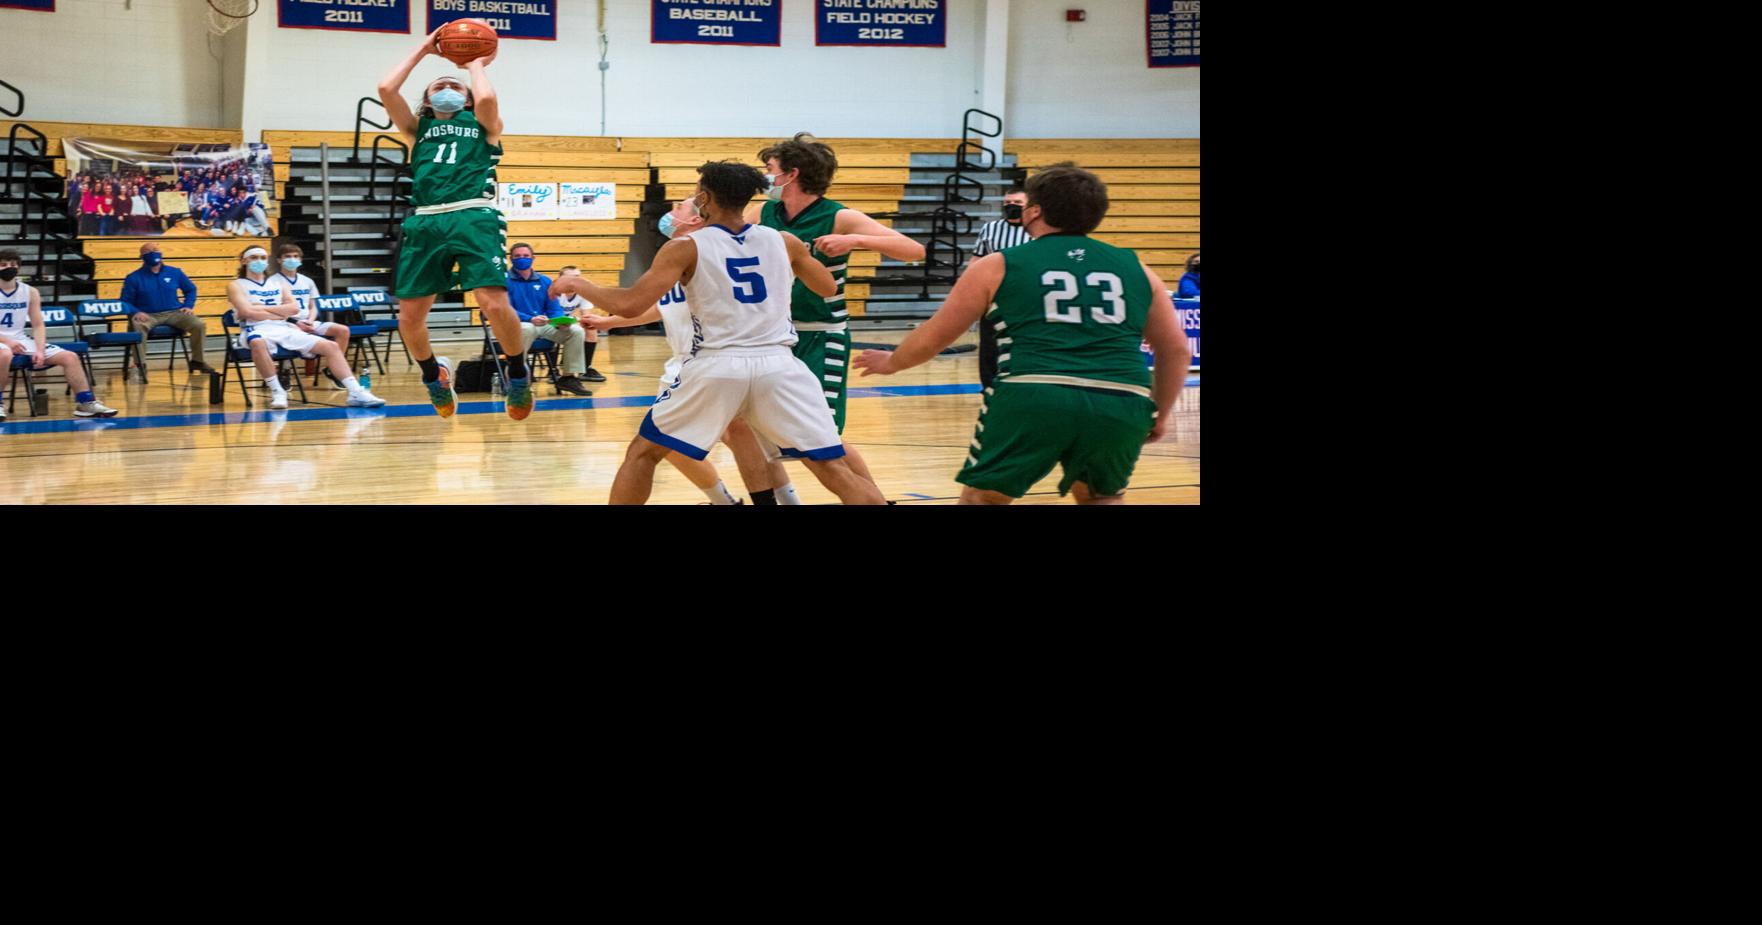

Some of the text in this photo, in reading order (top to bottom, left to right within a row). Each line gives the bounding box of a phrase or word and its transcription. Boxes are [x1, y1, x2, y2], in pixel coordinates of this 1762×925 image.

[433, 0, 551, 16] BOYS BASKETBALL
[823, 0, 938, 9] STATE CHAMPIONS
[324, 9, 364, 23] 2011
[669, 8, 763, 22] BASEBALL
[826, 12, 935, 25] FIELD HOCKEY
[480, 18, 511, 31] 011
[697, 25, 734, 37] 2011
[858, 28, 904, 40] 2012
[418, 124, 480, 143] NOSBURG
[433, 141, 458, 165] 11
[508, 183, 553, 203] Emily
[725, 256, 768, 304] 5
[318, 297, 353, 309] MVU
[352, 292, 385, 304] MVU
[1041, 270, 1126, 324] 23
[84, 302, 123, 314] MVU
[29, 309, 66, 322] VU
